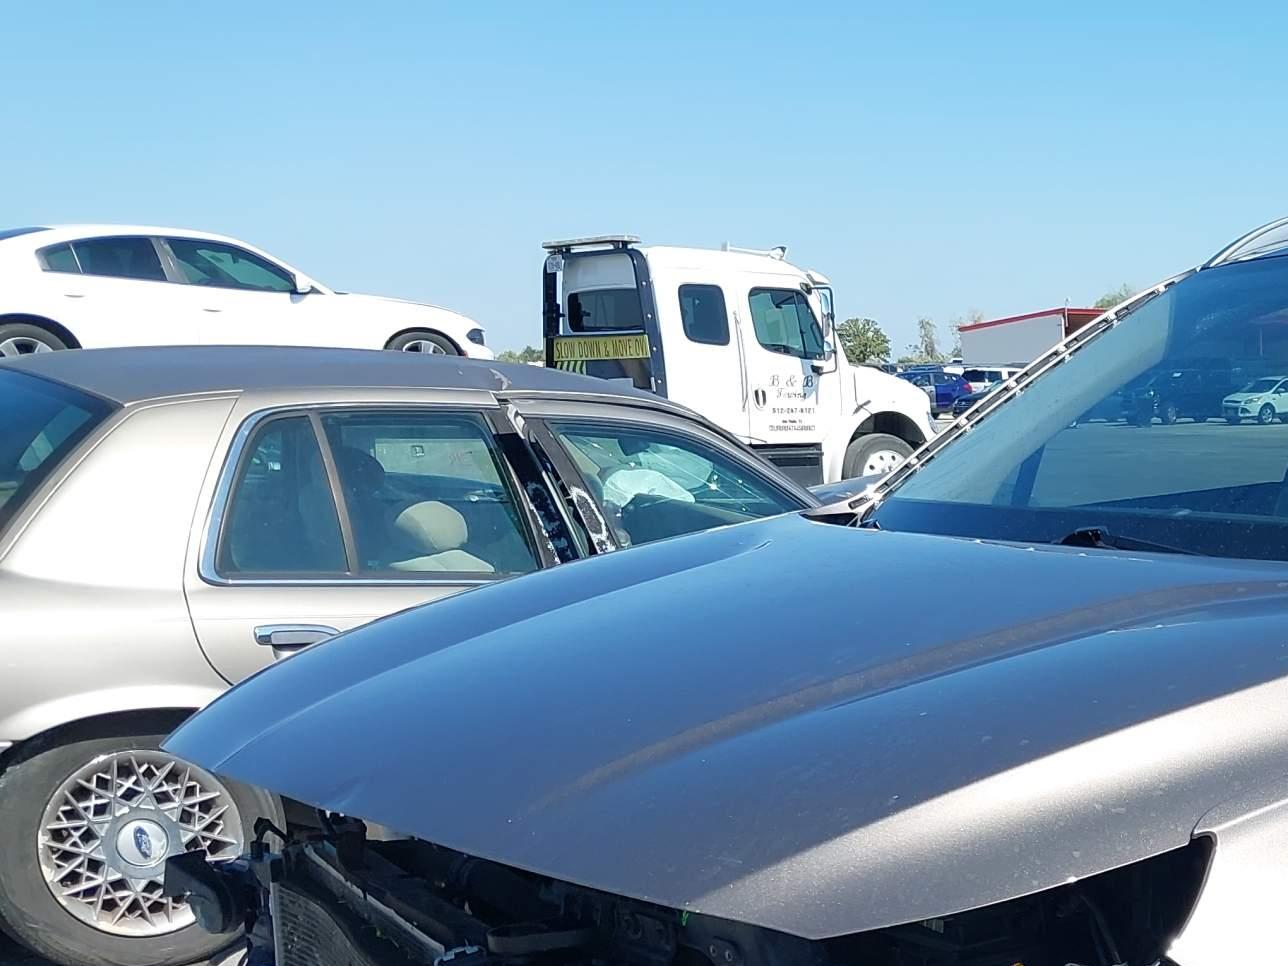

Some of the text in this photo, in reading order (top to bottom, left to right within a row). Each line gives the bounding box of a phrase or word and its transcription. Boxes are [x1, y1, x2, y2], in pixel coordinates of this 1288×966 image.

[555, 341, 575, 359] SLOW
[578, 340, 600, 358] DOWN
[604, 342, 610, 357] &
[611, 338, 632, 357] MOVE
[768, 374, 814, 388] B & B
[776, 387, 807, 401] Towing
